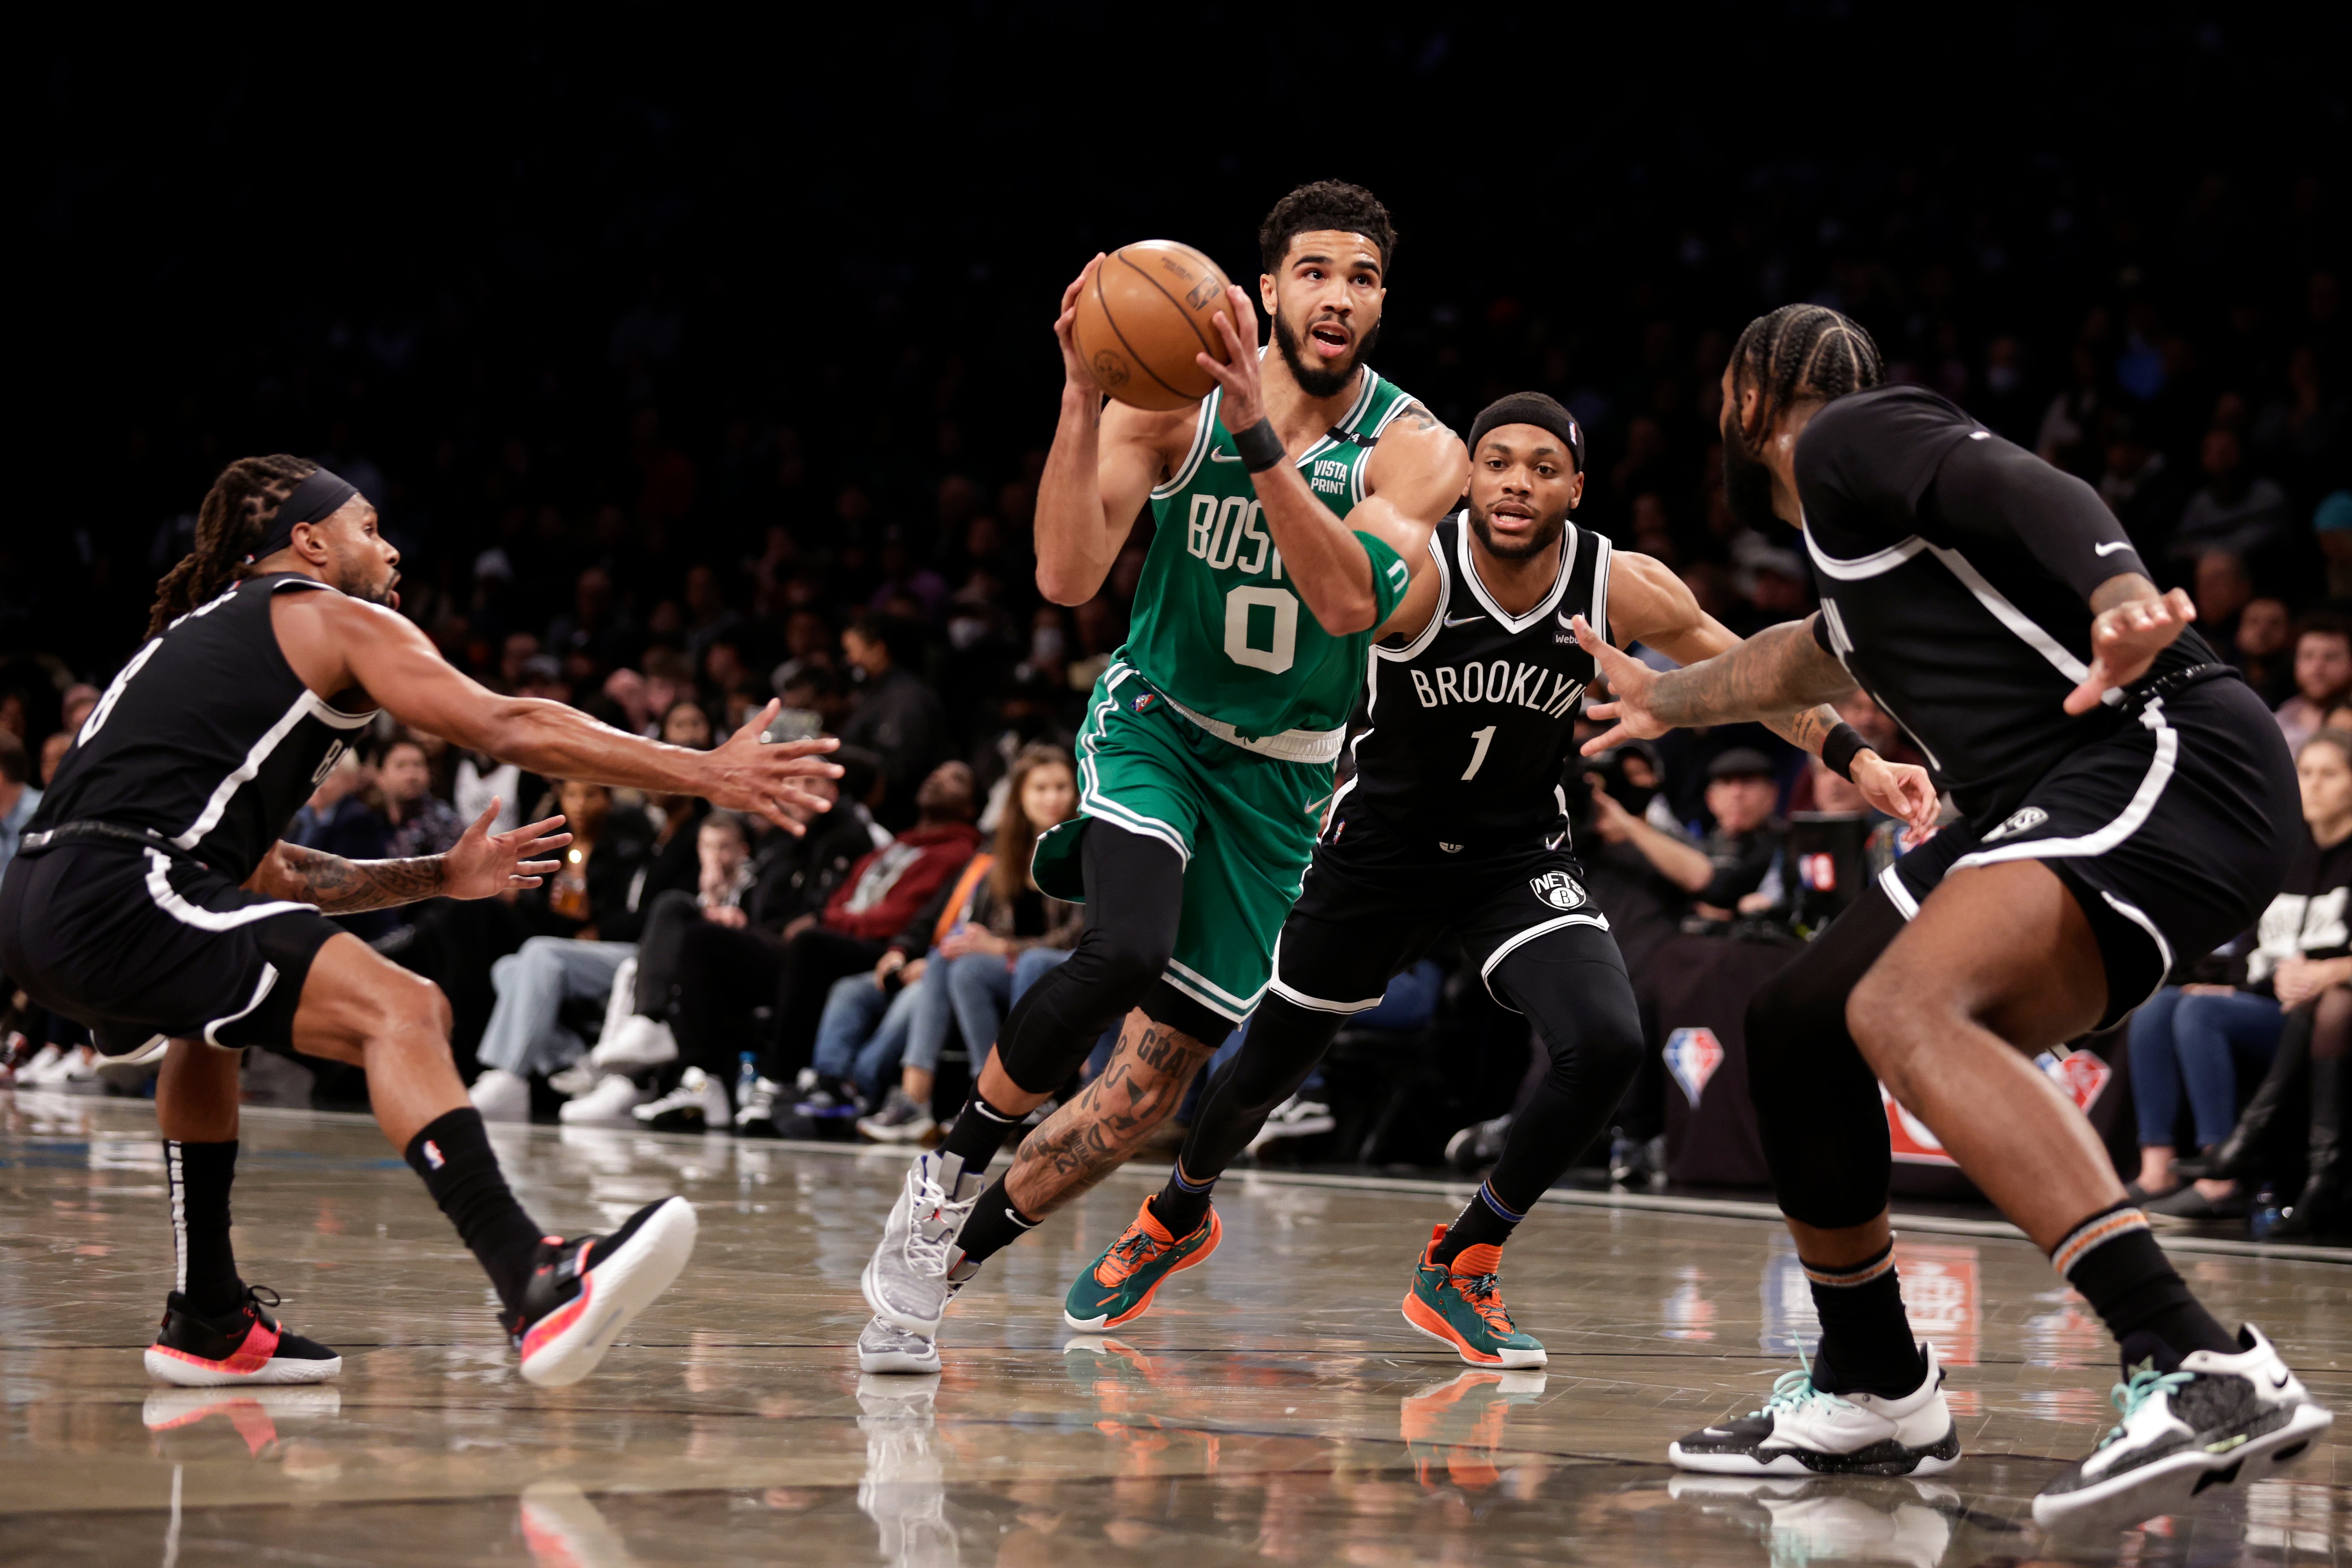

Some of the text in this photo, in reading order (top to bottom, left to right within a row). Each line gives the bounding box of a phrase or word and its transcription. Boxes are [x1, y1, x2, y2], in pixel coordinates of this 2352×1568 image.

[1314, 460, 1348, 482] VISTA
[1311, 477, 1345, 494] PRINT
[1187, 494, 1282, 580] BOS
[1224, 585, 1299, 675] 0
[1556, 634, 1580, 644] Webu
[1411, 660, 1586, 718] BROOKLYN
[1461, 725, 1497, 780] 1
[1534, 872, 1584, 896] NETS
[1559, 890, 1570, 904] B
